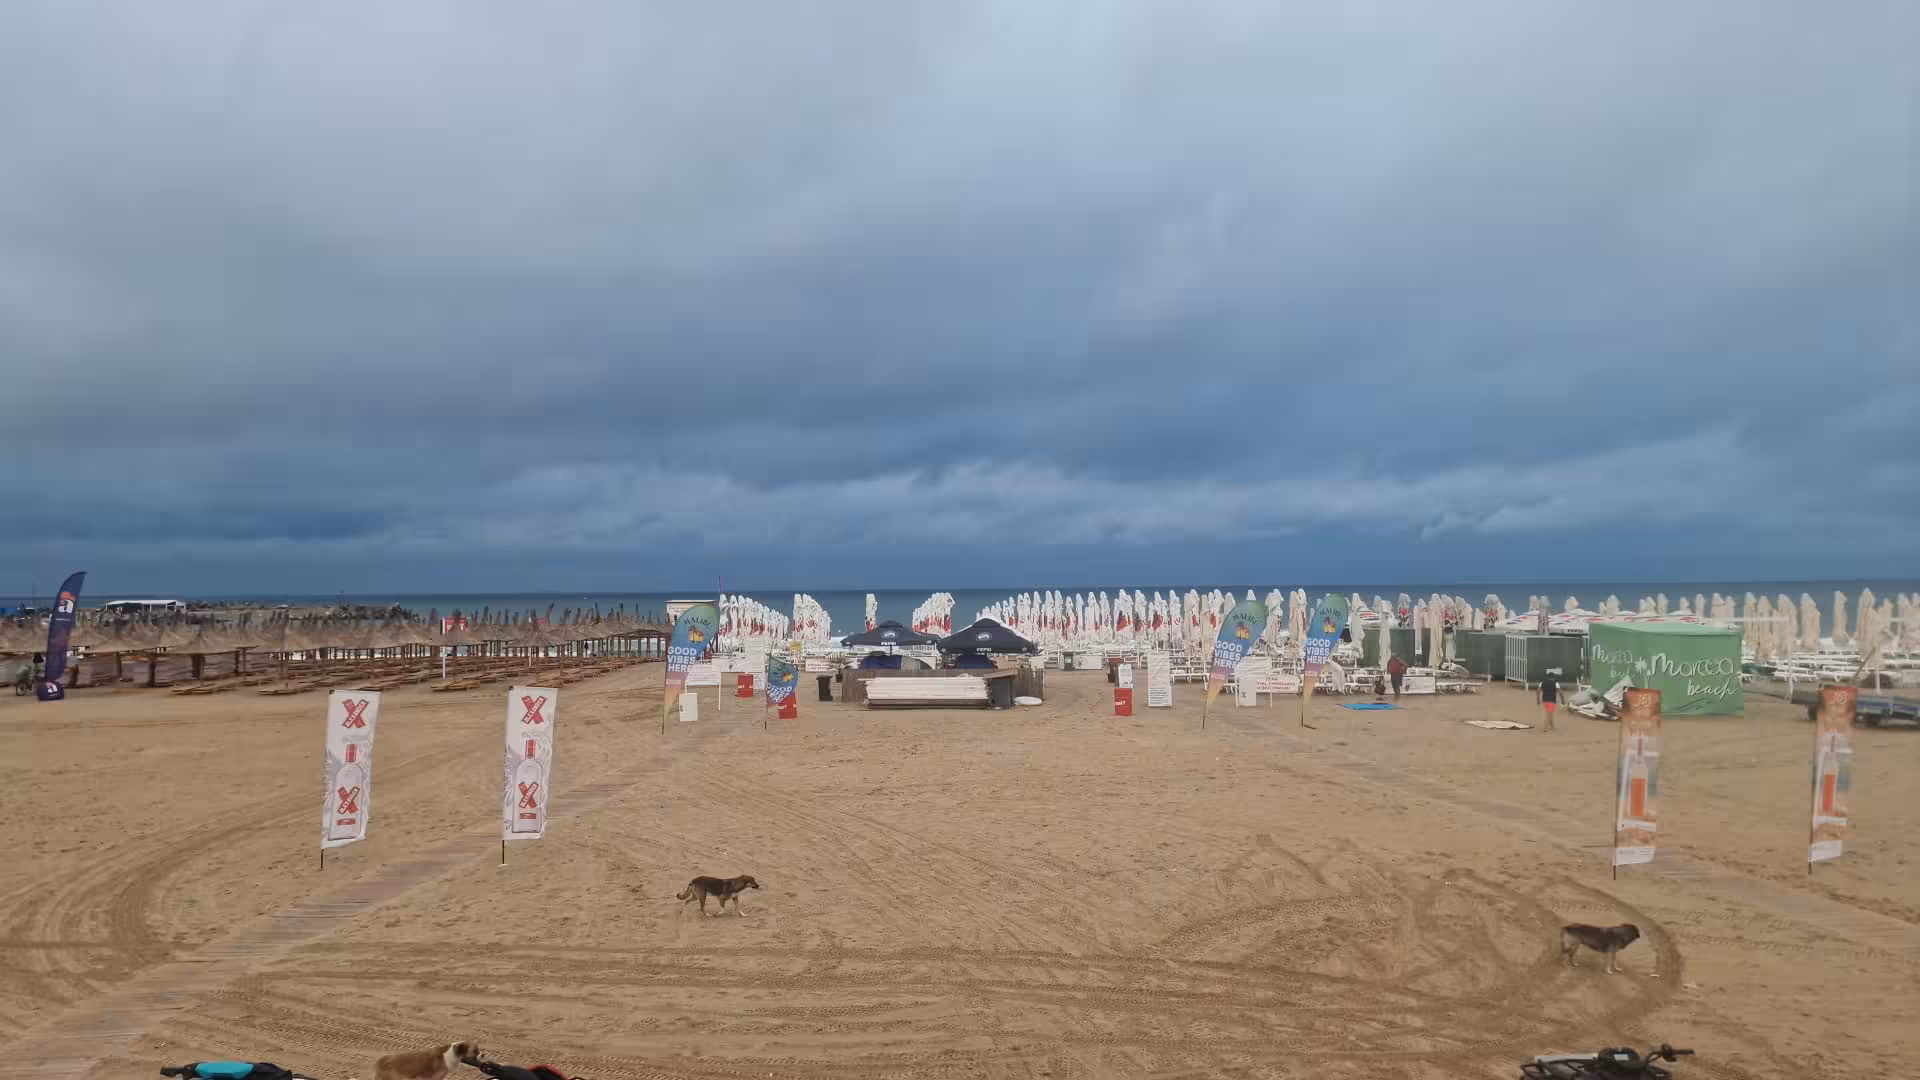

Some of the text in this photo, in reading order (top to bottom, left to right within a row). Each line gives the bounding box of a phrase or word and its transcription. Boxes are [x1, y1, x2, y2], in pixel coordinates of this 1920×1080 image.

[1215, 640, 1243, 653] GOOD
[1306, 638, 1331, 648] GOOD
[667, 646, 697, 656] GOOD
[1215, 649, 1241, 662] VIBES
[1306, 646, 1330, 657] VIBES
[667, 655, 696, 664] VIBES
[1687, 677, 1737, 700] beach
